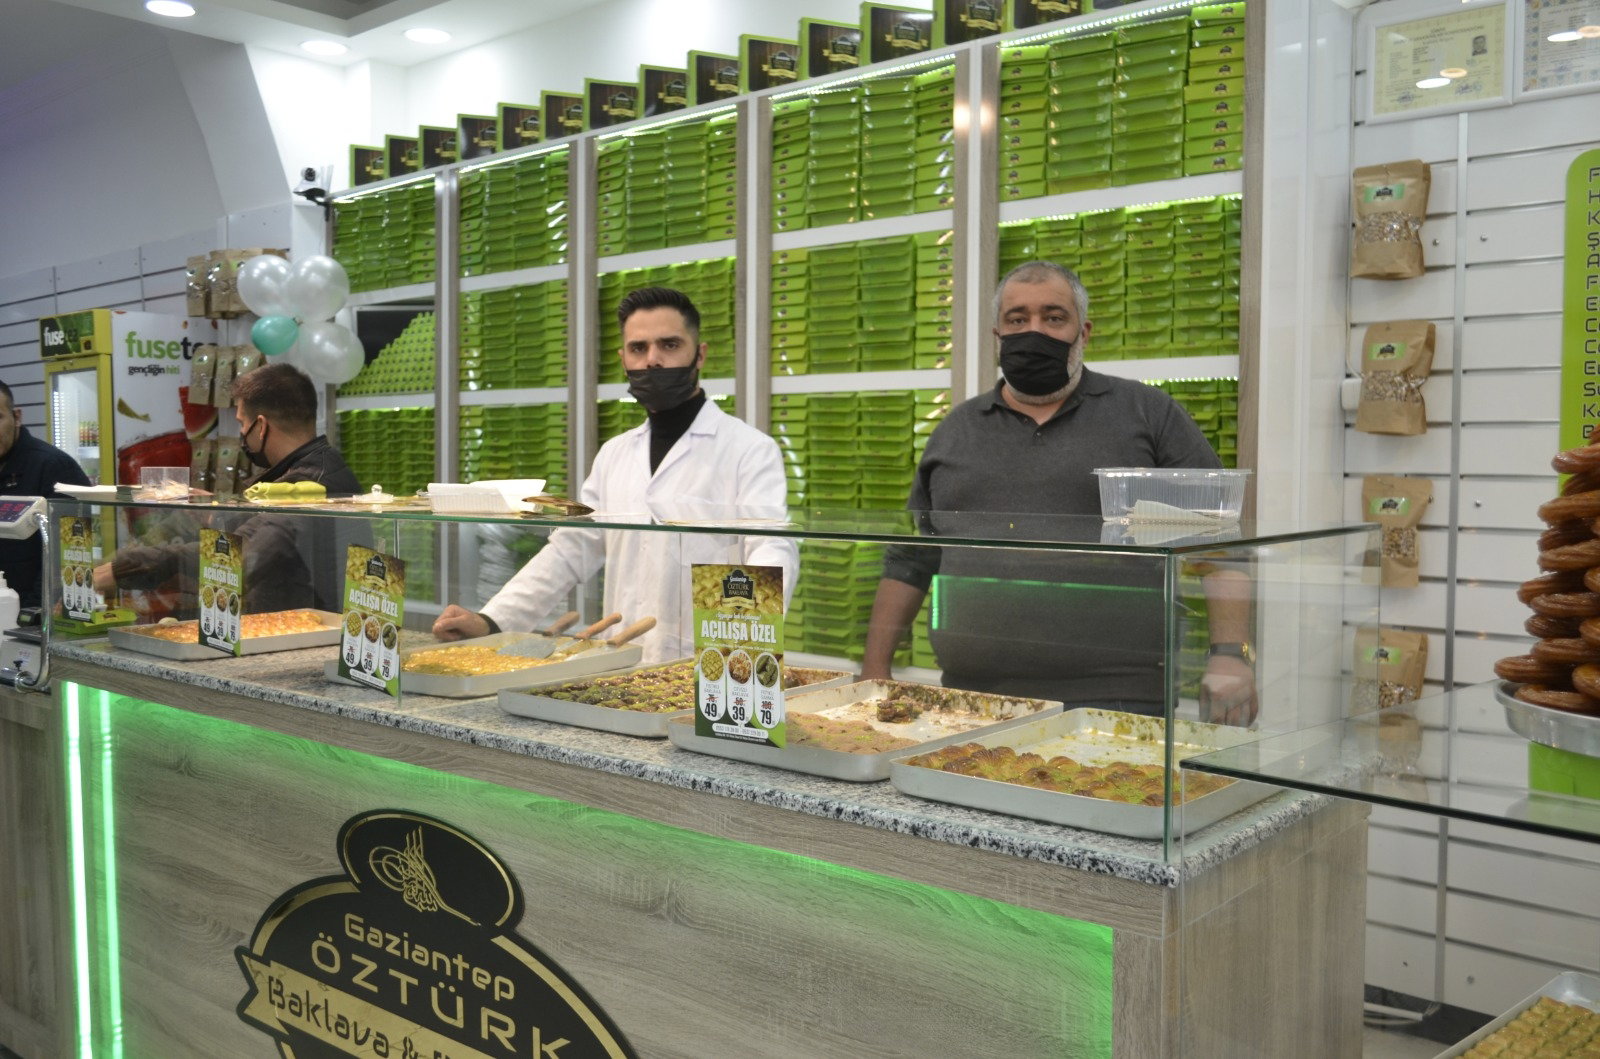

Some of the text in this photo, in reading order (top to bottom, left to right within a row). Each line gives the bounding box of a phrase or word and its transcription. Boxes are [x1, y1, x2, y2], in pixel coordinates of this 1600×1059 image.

[125, 331, 218, 361] fuset
[701, 620, 777, 644] AÇILIŞA ÖZEL
[346, 652, 355, 664] 49
[363, 659, 373, 671] 39
[704, 703, 718, 717] 49
[733, 706, 745, 721] 39
[760, 710, 772, 725] 79
[344, 912, 515, 1002] Gaziantep
[311, 931, 571, 1059] ÖZTÜRK
[268, 974, 390, 1058] Baklava
